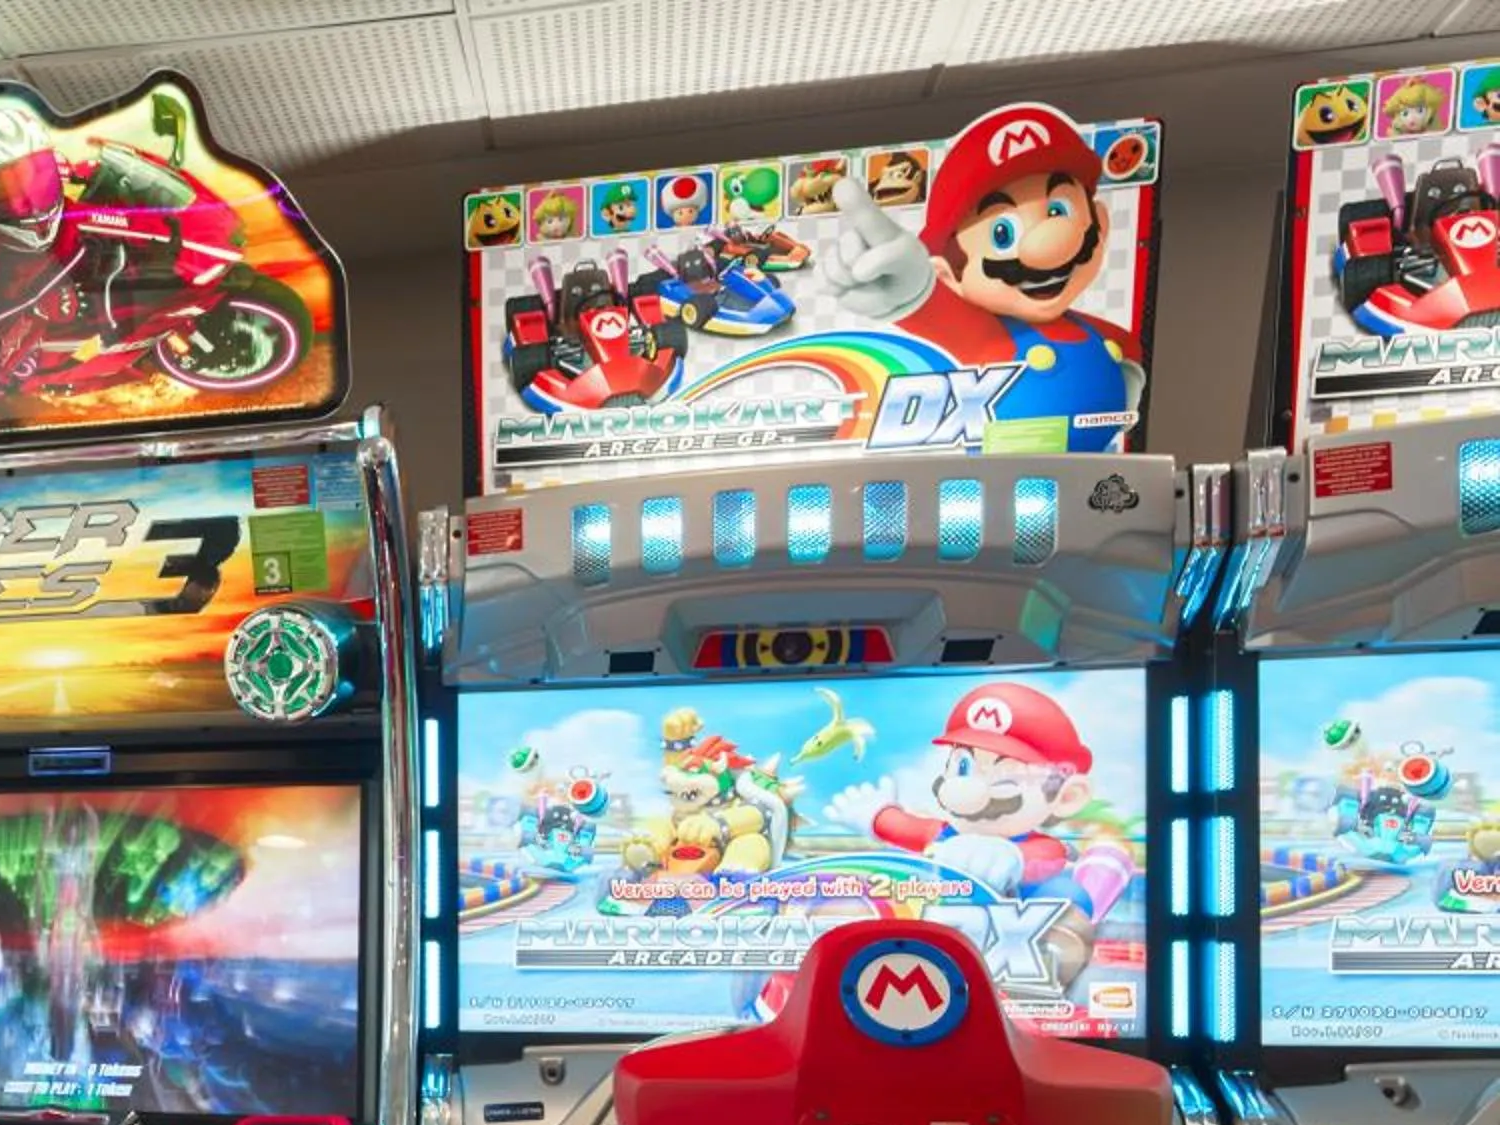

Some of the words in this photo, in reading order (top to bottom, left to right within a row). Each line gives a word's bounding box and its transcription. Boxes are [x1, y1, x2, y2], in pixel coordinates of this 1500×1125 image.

[866, 364, 1021, 449] DX
[1077, 413, 1133, 425] namco
[584, 437, 715, 459] ARCADE
[143, 514, 241, 616] 3
[263, 557, 282, 585] 3
[611, 879, 679, 900] Versus
[682, 883, 717, 899] can
[719, 879, 746, 899] be
[750, 879, 816, 902] played
[821, 876, 864, 897] with
[868, 878, 891, 900] 2
[896, 878, 973, 901] players
[606, 950, 749, 965] ARCADE
